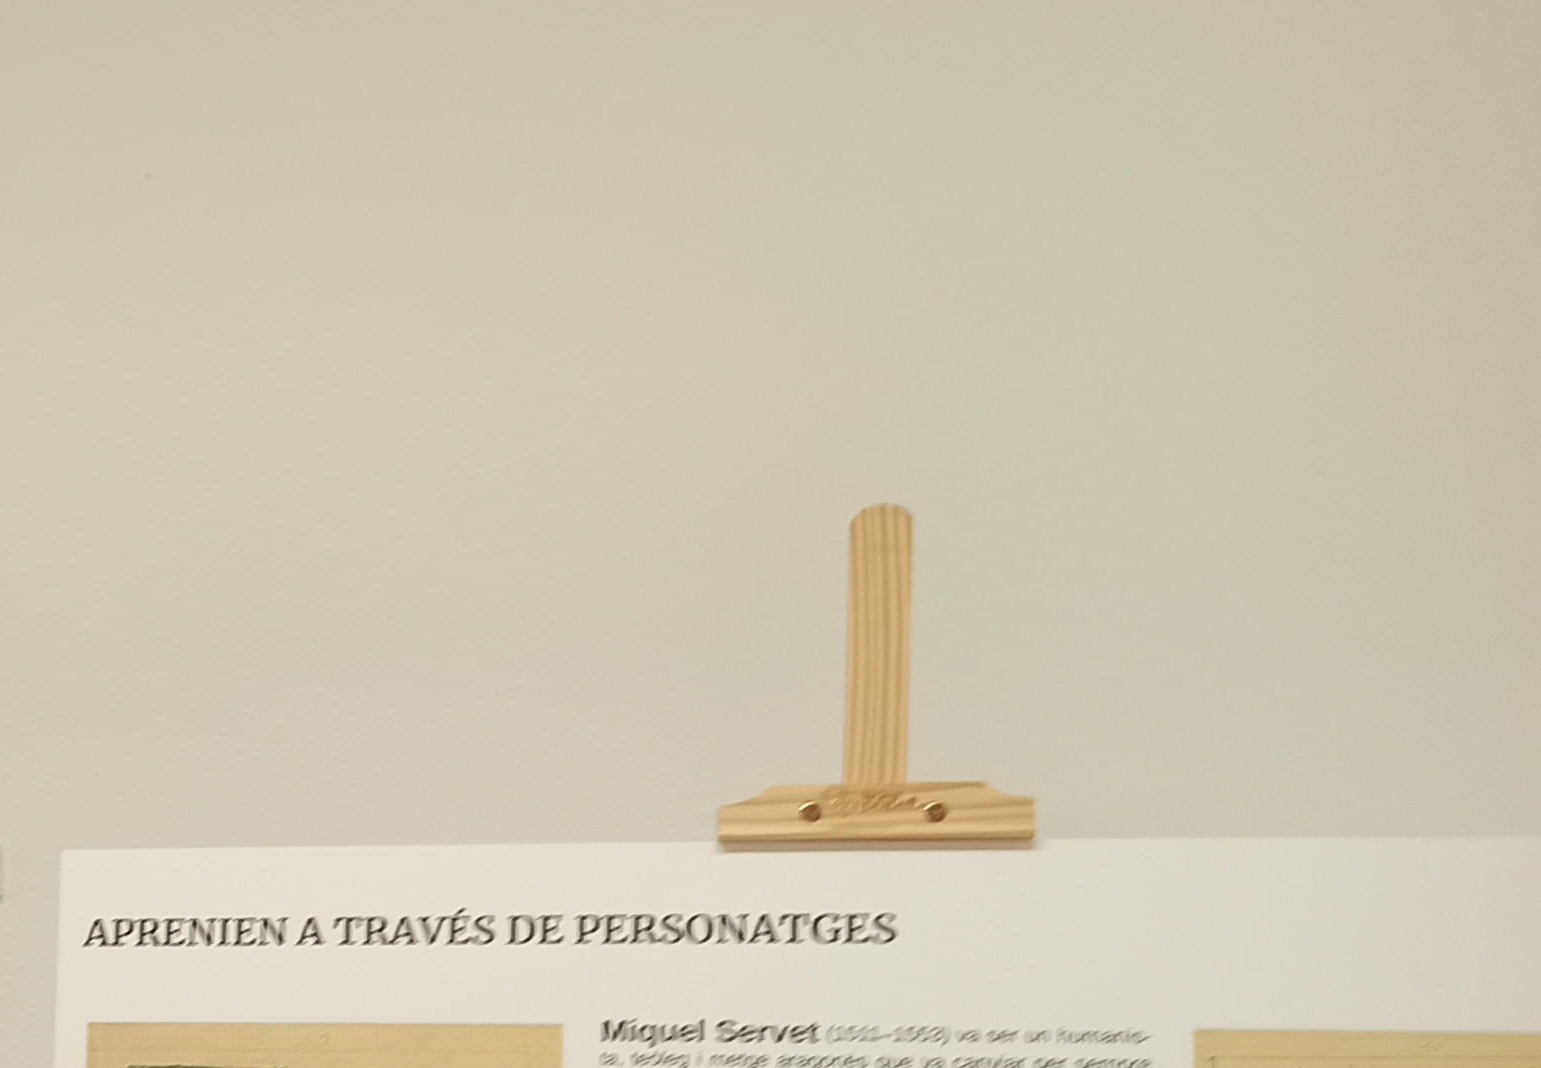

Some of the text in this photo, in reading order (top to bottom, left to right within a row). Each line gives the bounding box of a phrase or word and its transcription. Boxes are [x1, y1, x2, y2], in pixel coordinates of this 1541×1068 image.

[81, 911, 900, 948] APRENIEN A TRAVÉS DE PERSONATGES
[599, 1019, 707, 1047] Miquel
[713, 1020, 822, 1045] Servet
